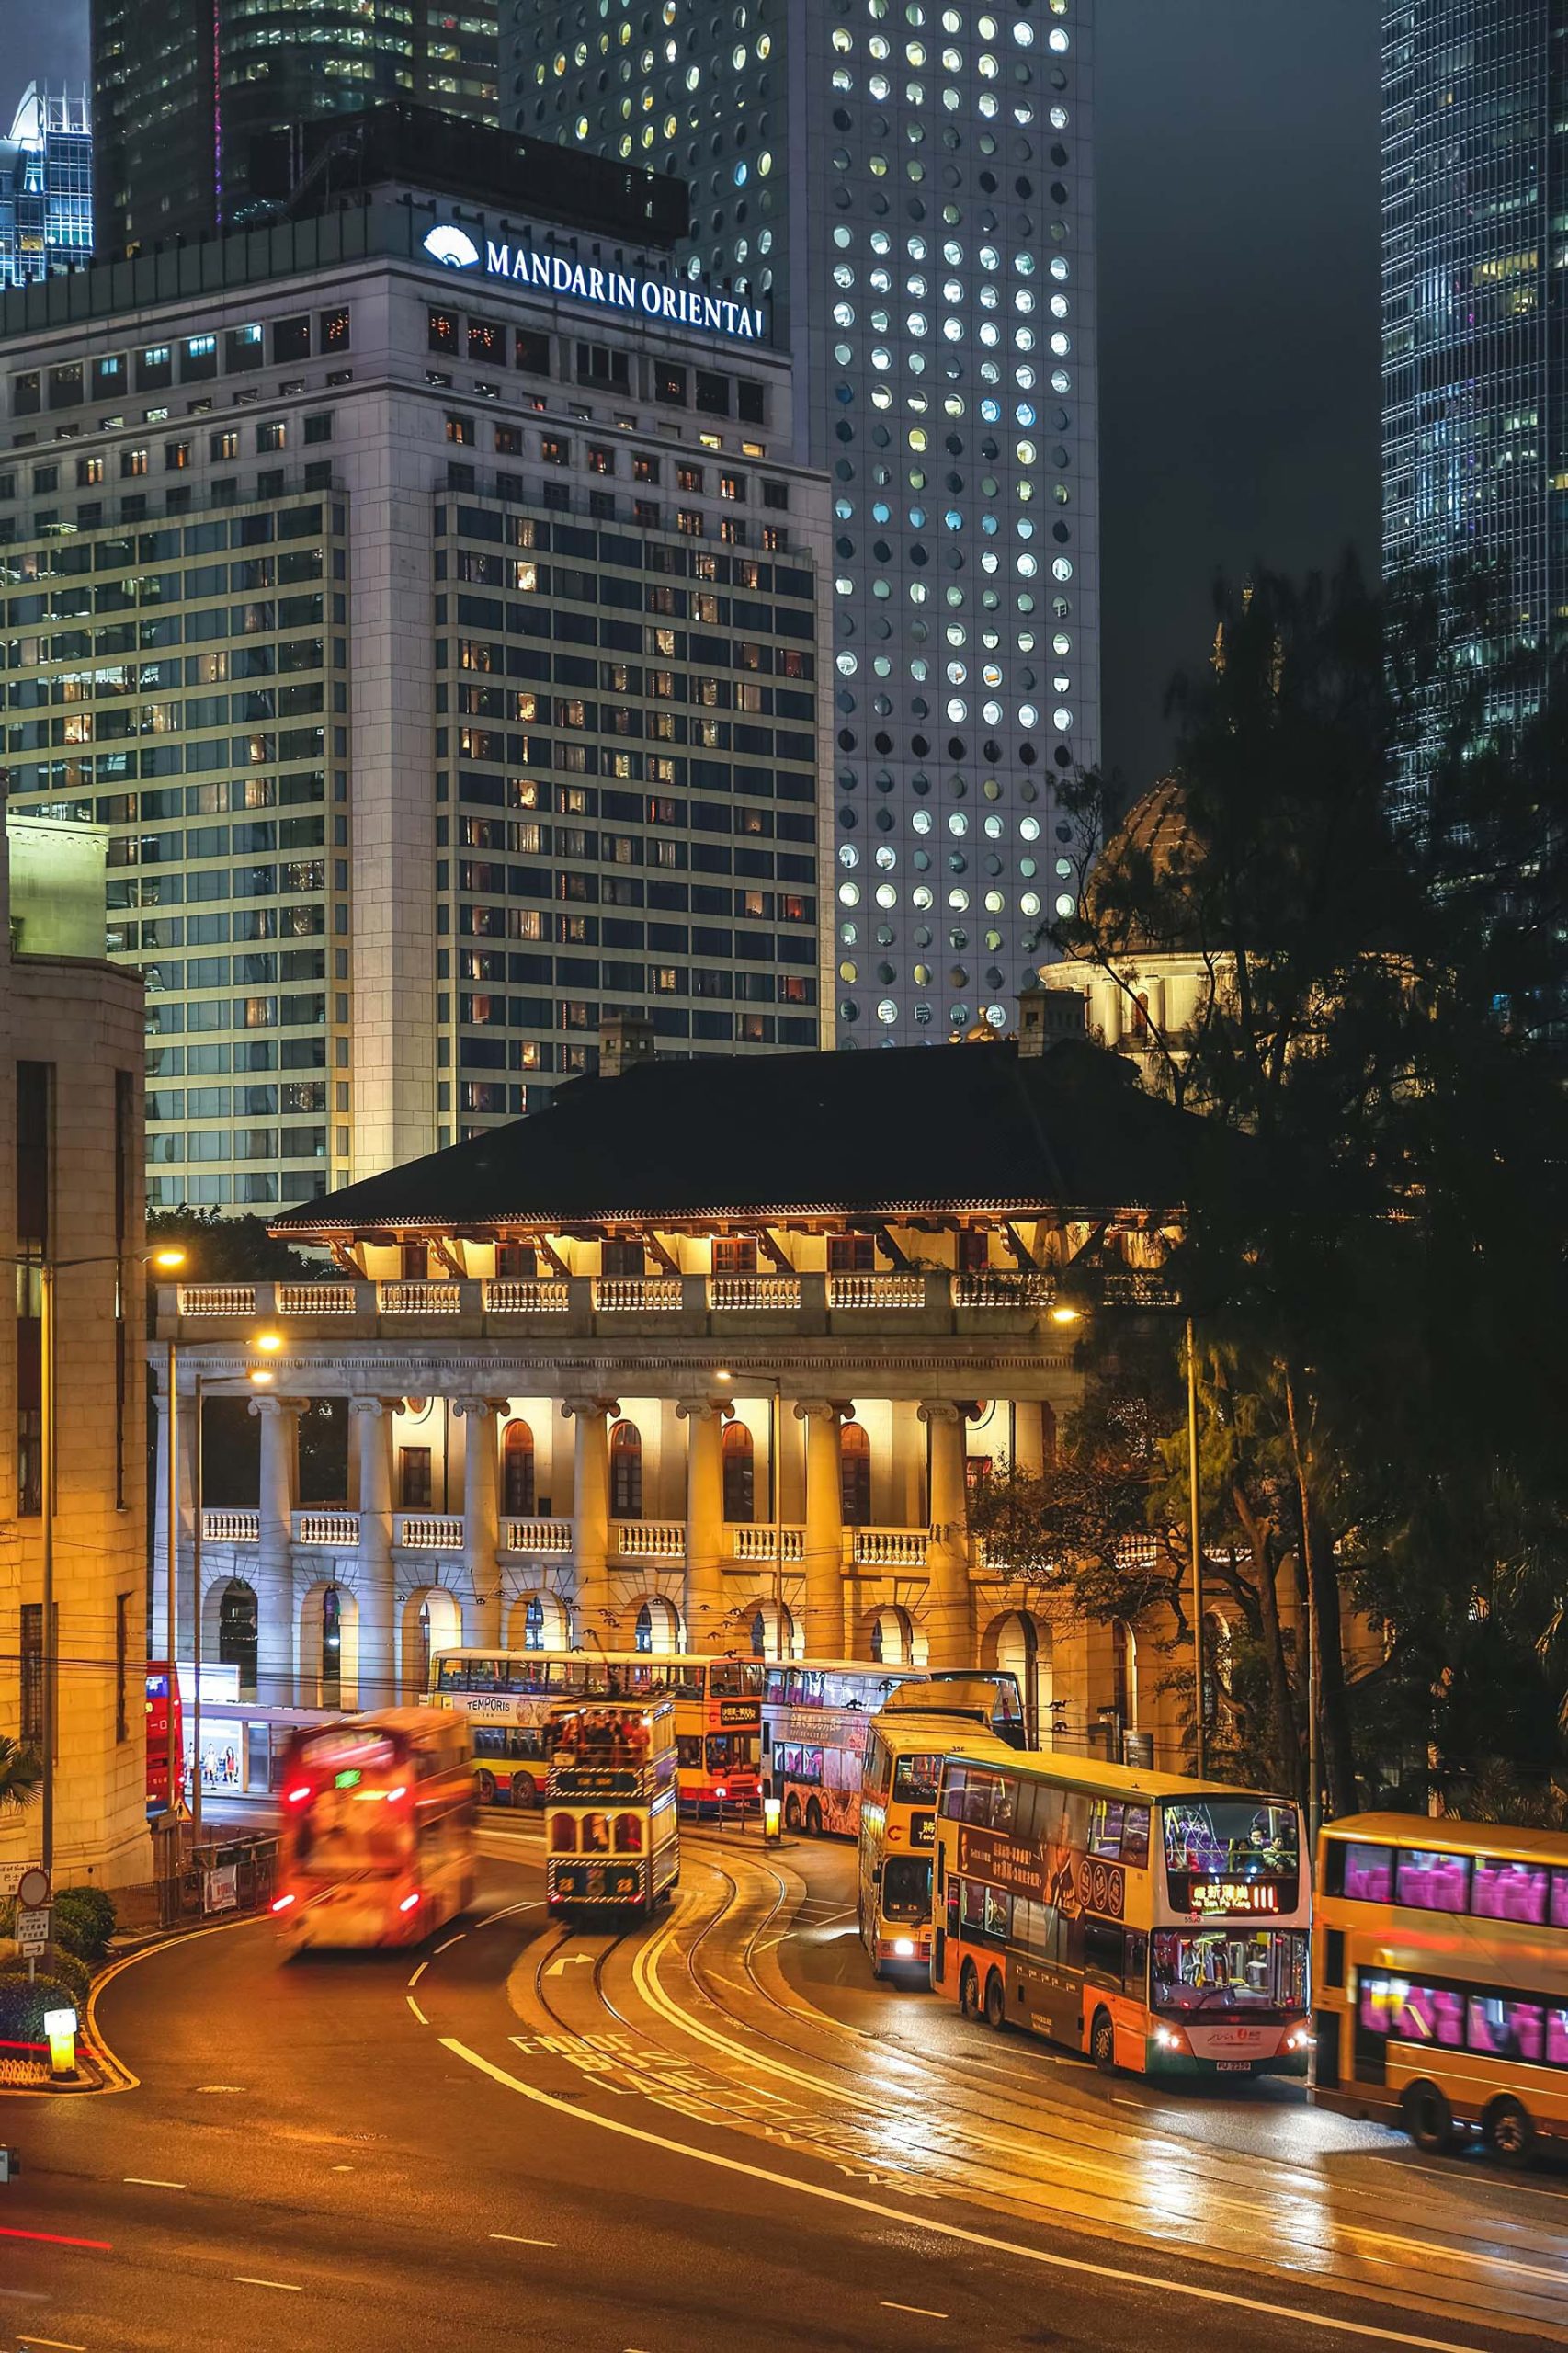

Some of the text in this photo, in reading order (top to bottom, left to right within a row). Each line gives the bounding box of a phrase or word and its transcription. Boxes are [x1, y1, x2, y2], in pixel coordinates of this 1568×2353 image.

[485, 240, 636, 308] MANDARIN
[467, 1697, 510, 1711] TEMPORIS
[1254, 1886, 1274, 1909] 111
[507, 2033, 634, 2055] END OF
[562, 2051, 692, 2073] BUS
[582, 2070, 729, 2096] LANE
